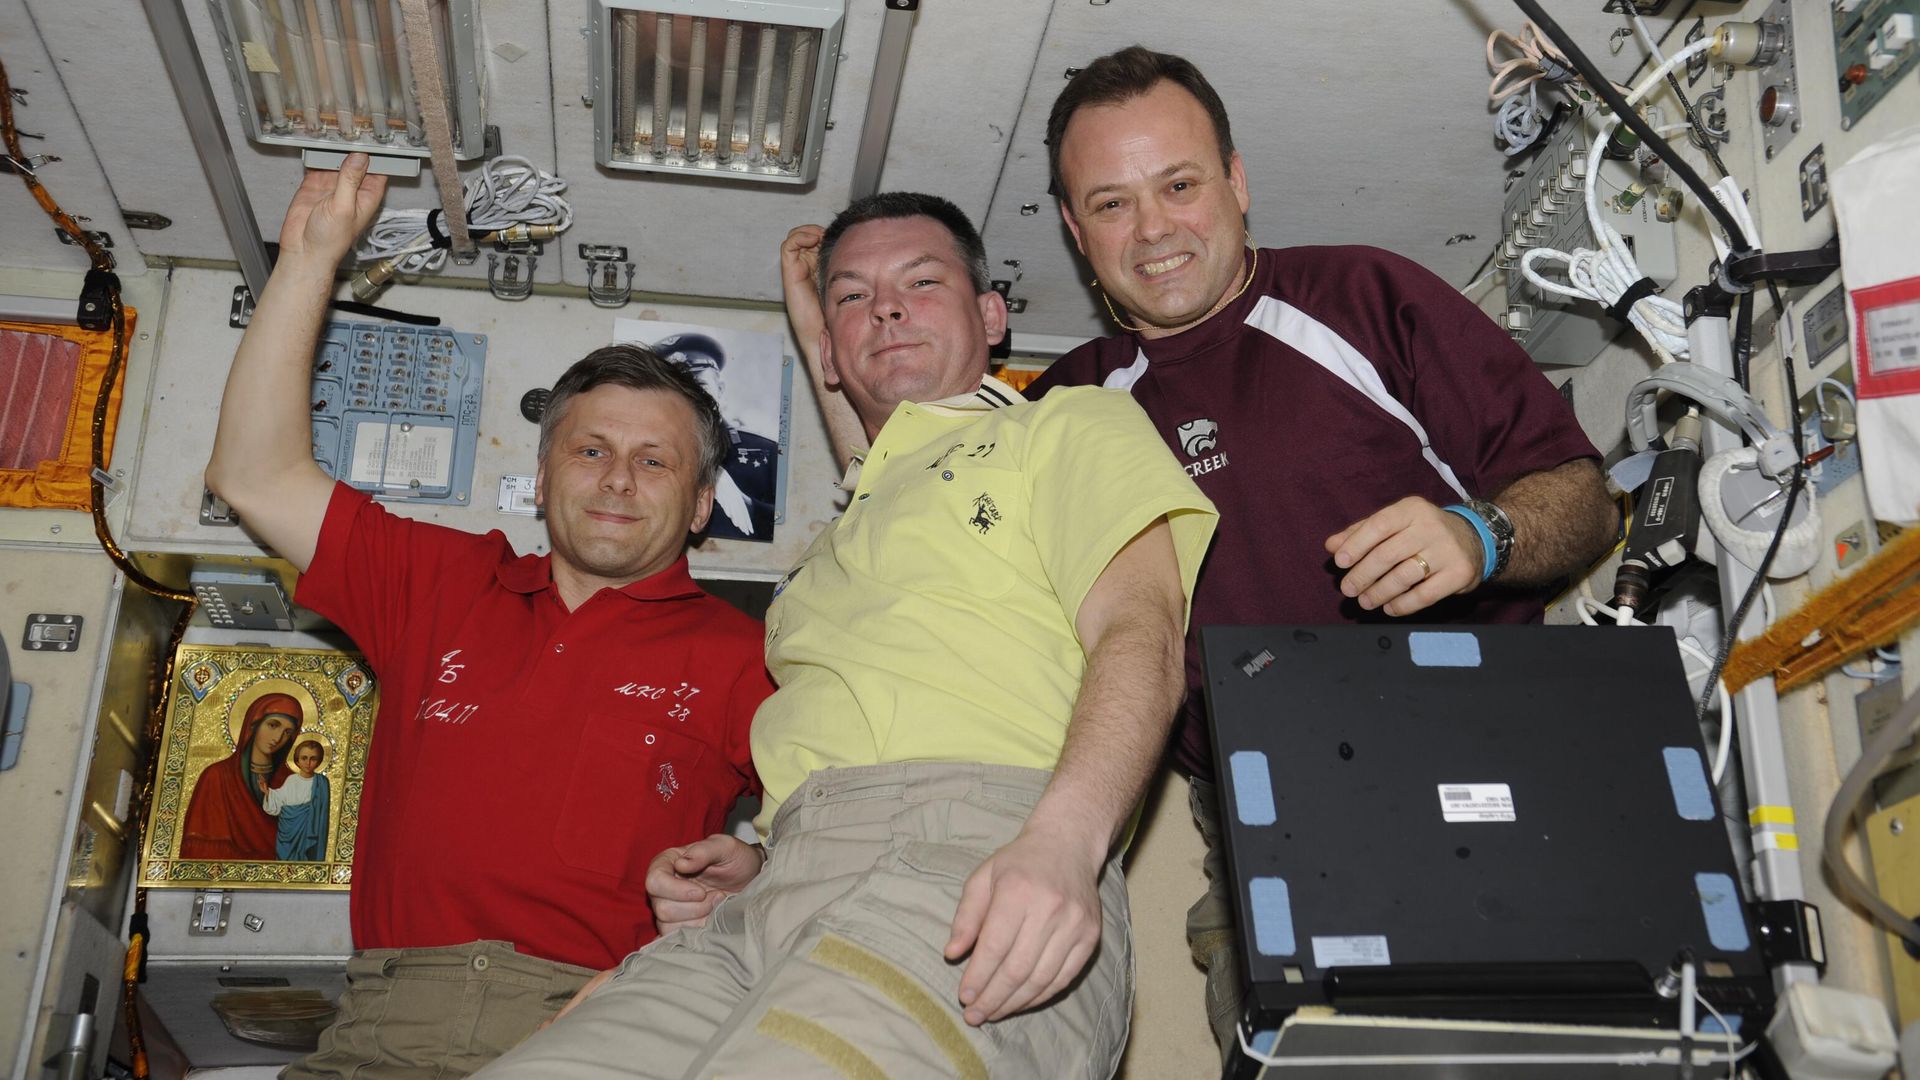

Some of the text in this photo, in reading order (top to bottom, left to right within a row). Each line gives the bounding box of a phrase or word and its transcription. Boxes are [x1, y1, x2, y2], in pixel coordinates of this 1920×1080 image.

[1184, 451, 1230, 477] CREEK
[673, 682, 701, 701] 27
[667, 703, 691, 722] 28
